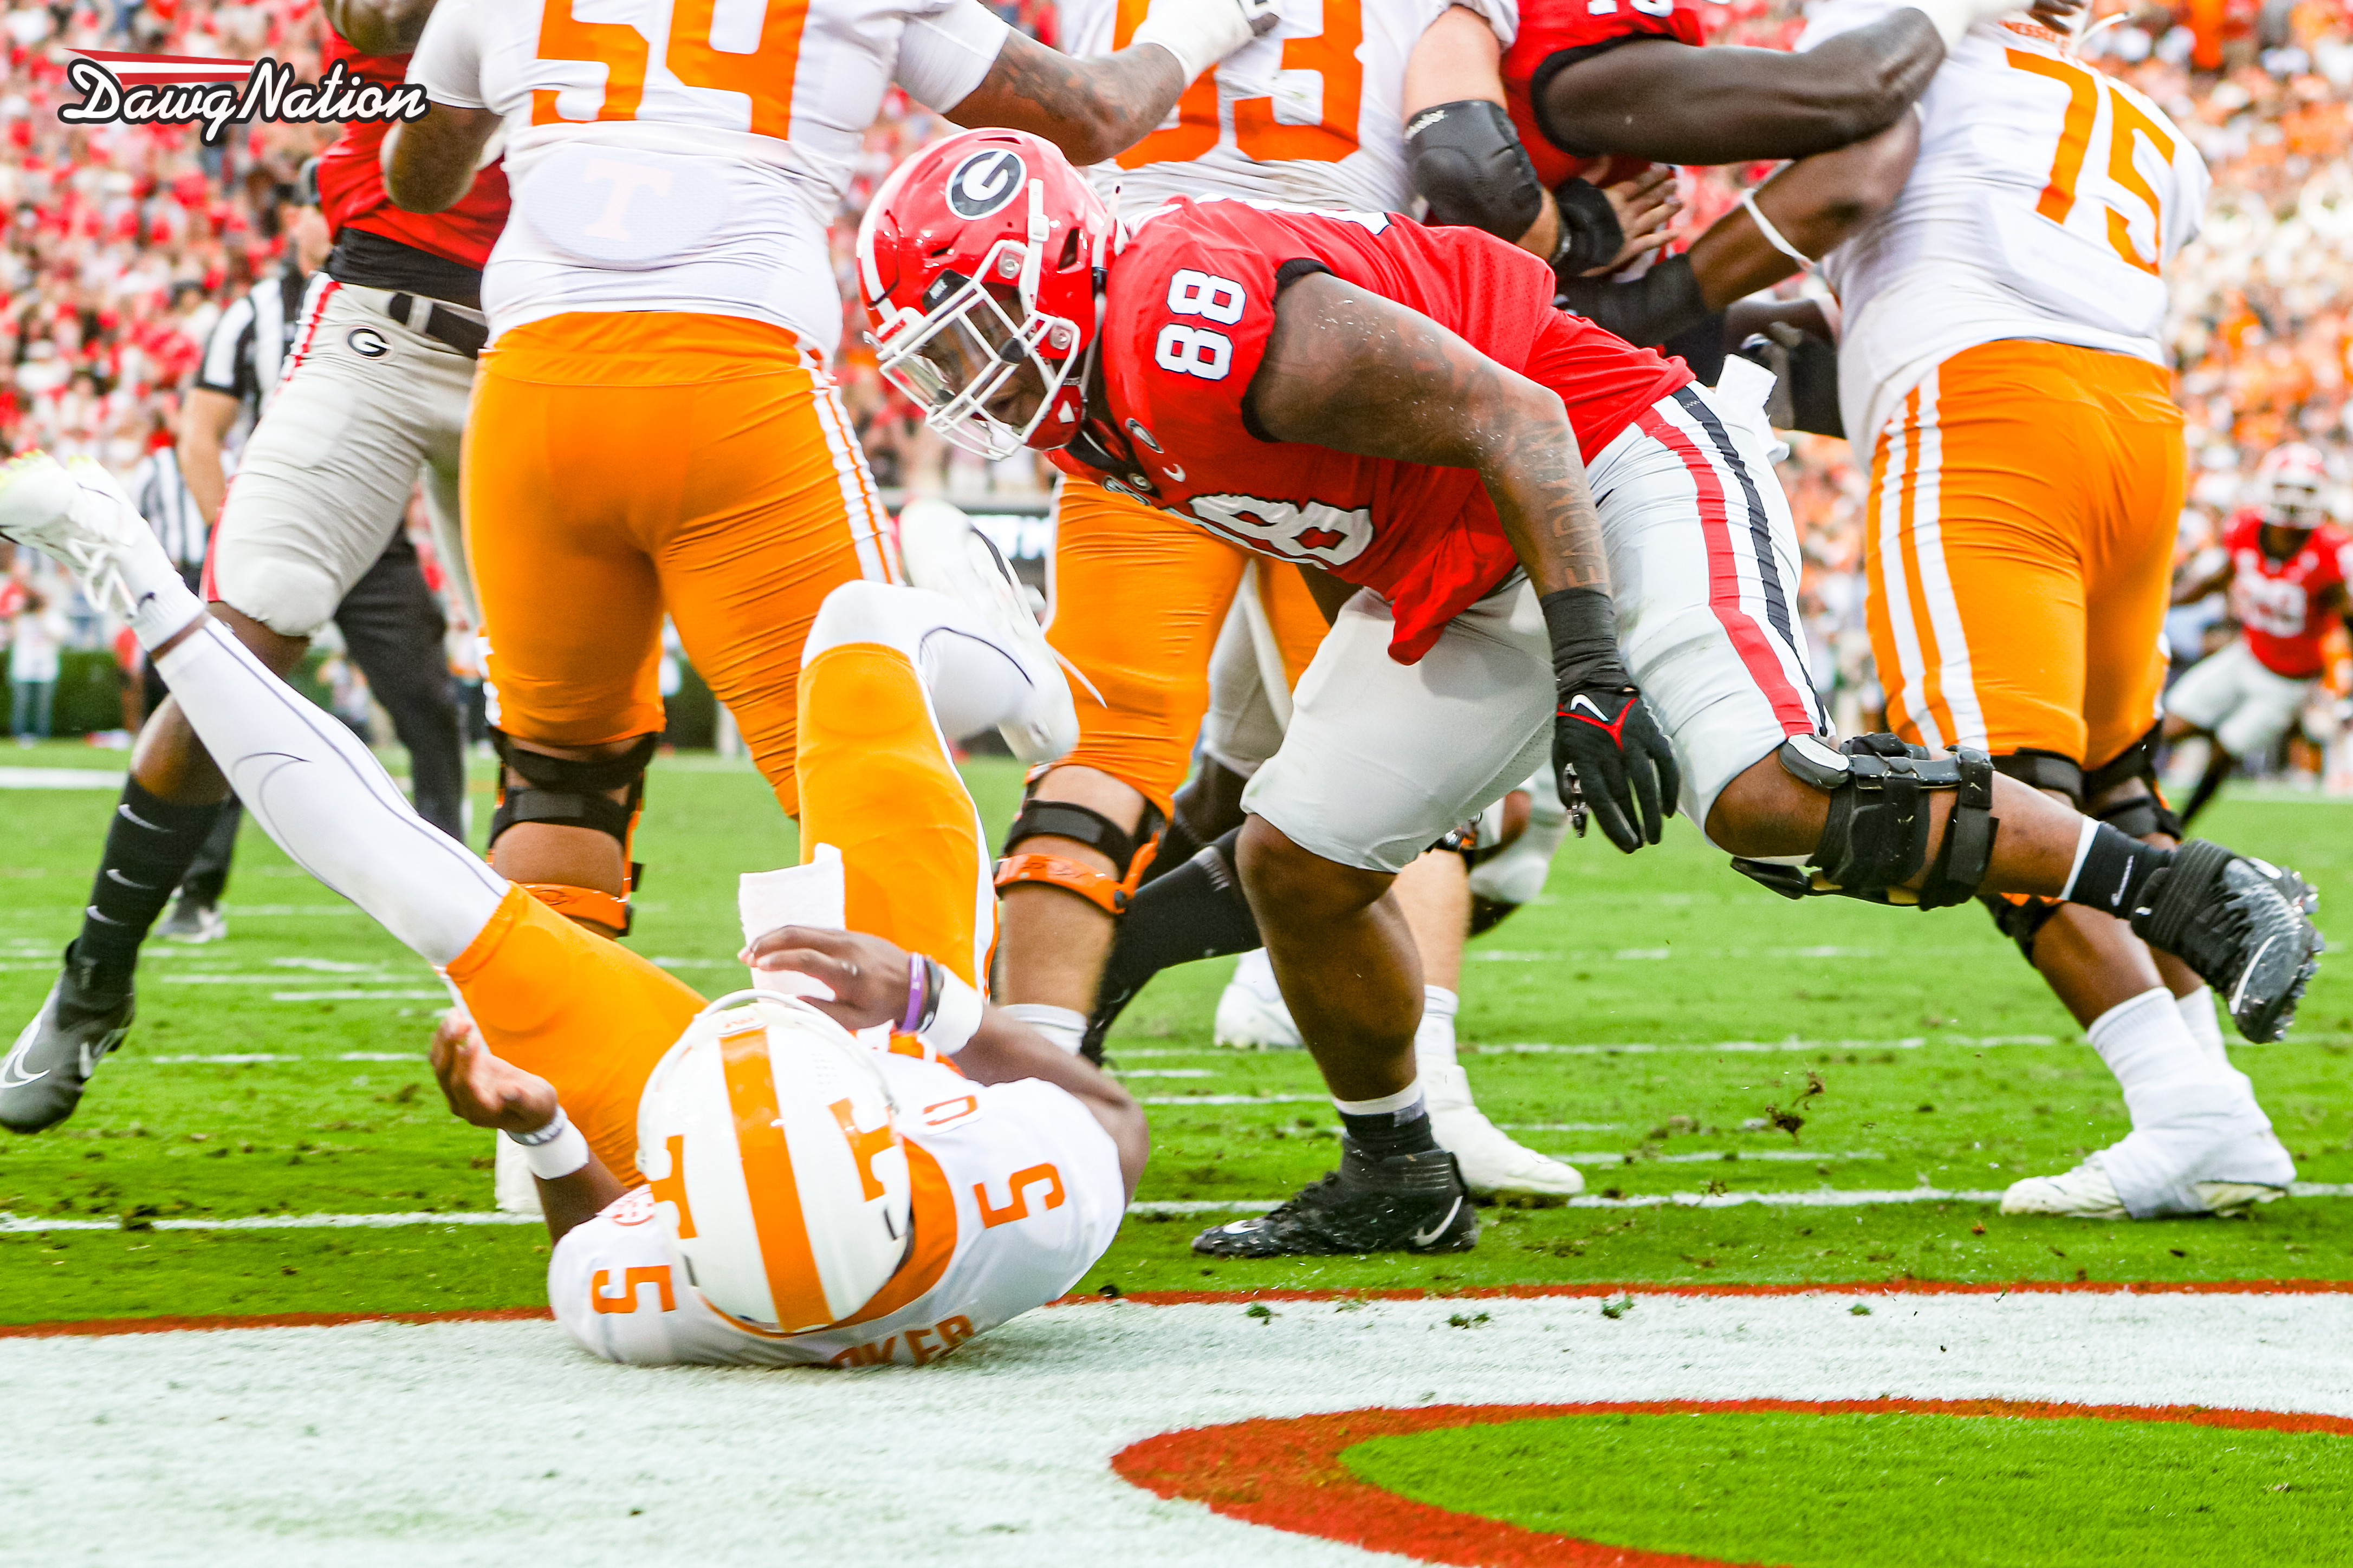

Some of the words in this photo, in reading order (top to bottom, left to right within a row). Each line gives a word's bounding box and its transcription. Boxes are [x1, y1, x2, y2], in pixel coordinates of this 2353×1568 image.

[530, 0, 811, 141] 54
[582, 158, 676, 243] T
[947, 148, 1027, 220] G
[2005, 48, 2176, 277] 75
[347, 328, 394, 357] G
[1155, 268, 1247, 381] 88
[1163, 493, 1373, 570] 8
[972, 1162, 1065, 1229] 5
[591, 1264, 677, 1314] 5
